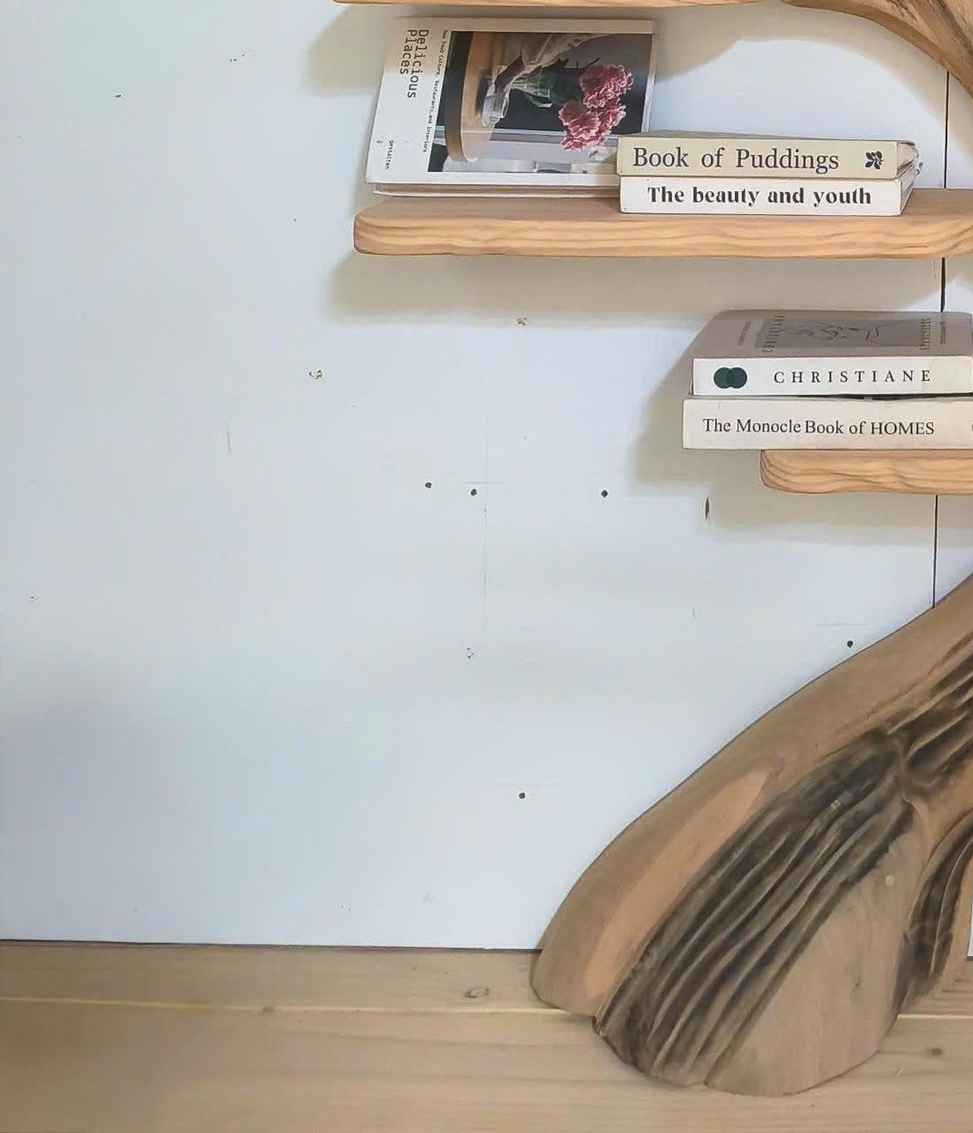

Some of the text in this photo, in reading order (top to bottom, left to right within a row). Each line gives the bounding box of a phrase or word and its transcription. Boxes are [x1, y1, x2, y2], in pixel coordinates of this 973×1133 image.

[399, 29, 418, 75] Places
[407, 29, 430, 99] Delicious
[632, 146, 840, 175] Book of Puddings
[647, 186, 872, 208] The beauty and youth
[773, 369, 932, 384] CHRISTIANE
[702, 418, 935, 435] The Monocle Book of HOMES
